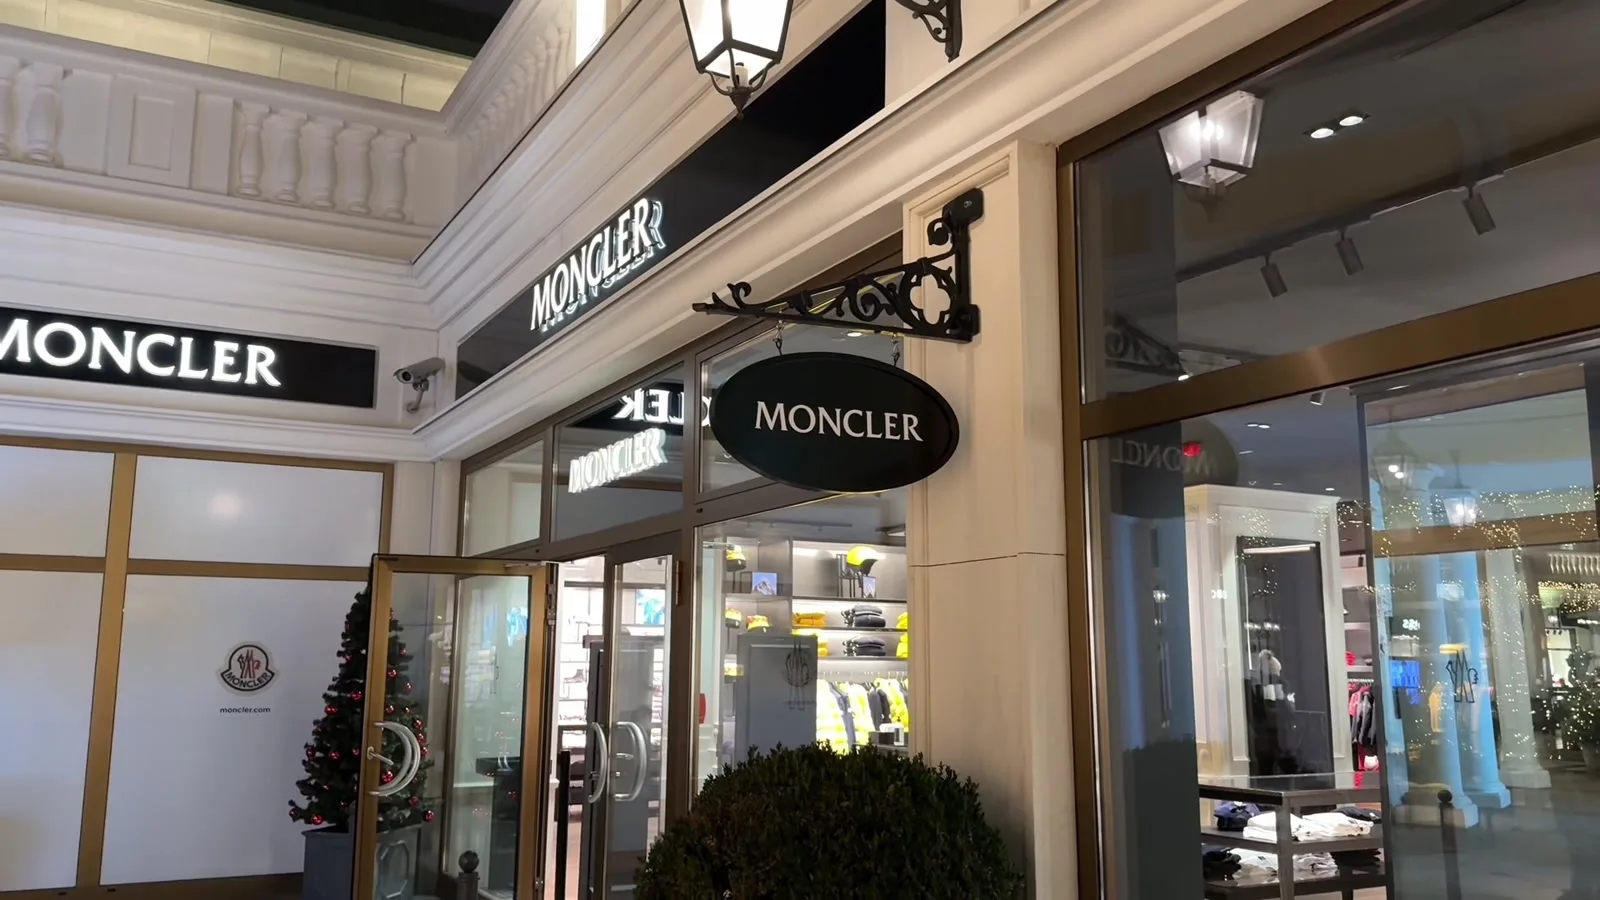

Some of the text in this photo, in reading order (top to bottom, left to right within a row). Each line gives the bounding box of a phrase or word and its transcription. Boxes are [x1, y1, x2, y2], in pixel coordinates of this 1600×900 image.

[530, 198, 652, 331] MONCLER
[755, 400, 923, 442] MONCLER
[568, 427, 667, 494] MONCLER
[225, 671, 271, 688] MONCLER
